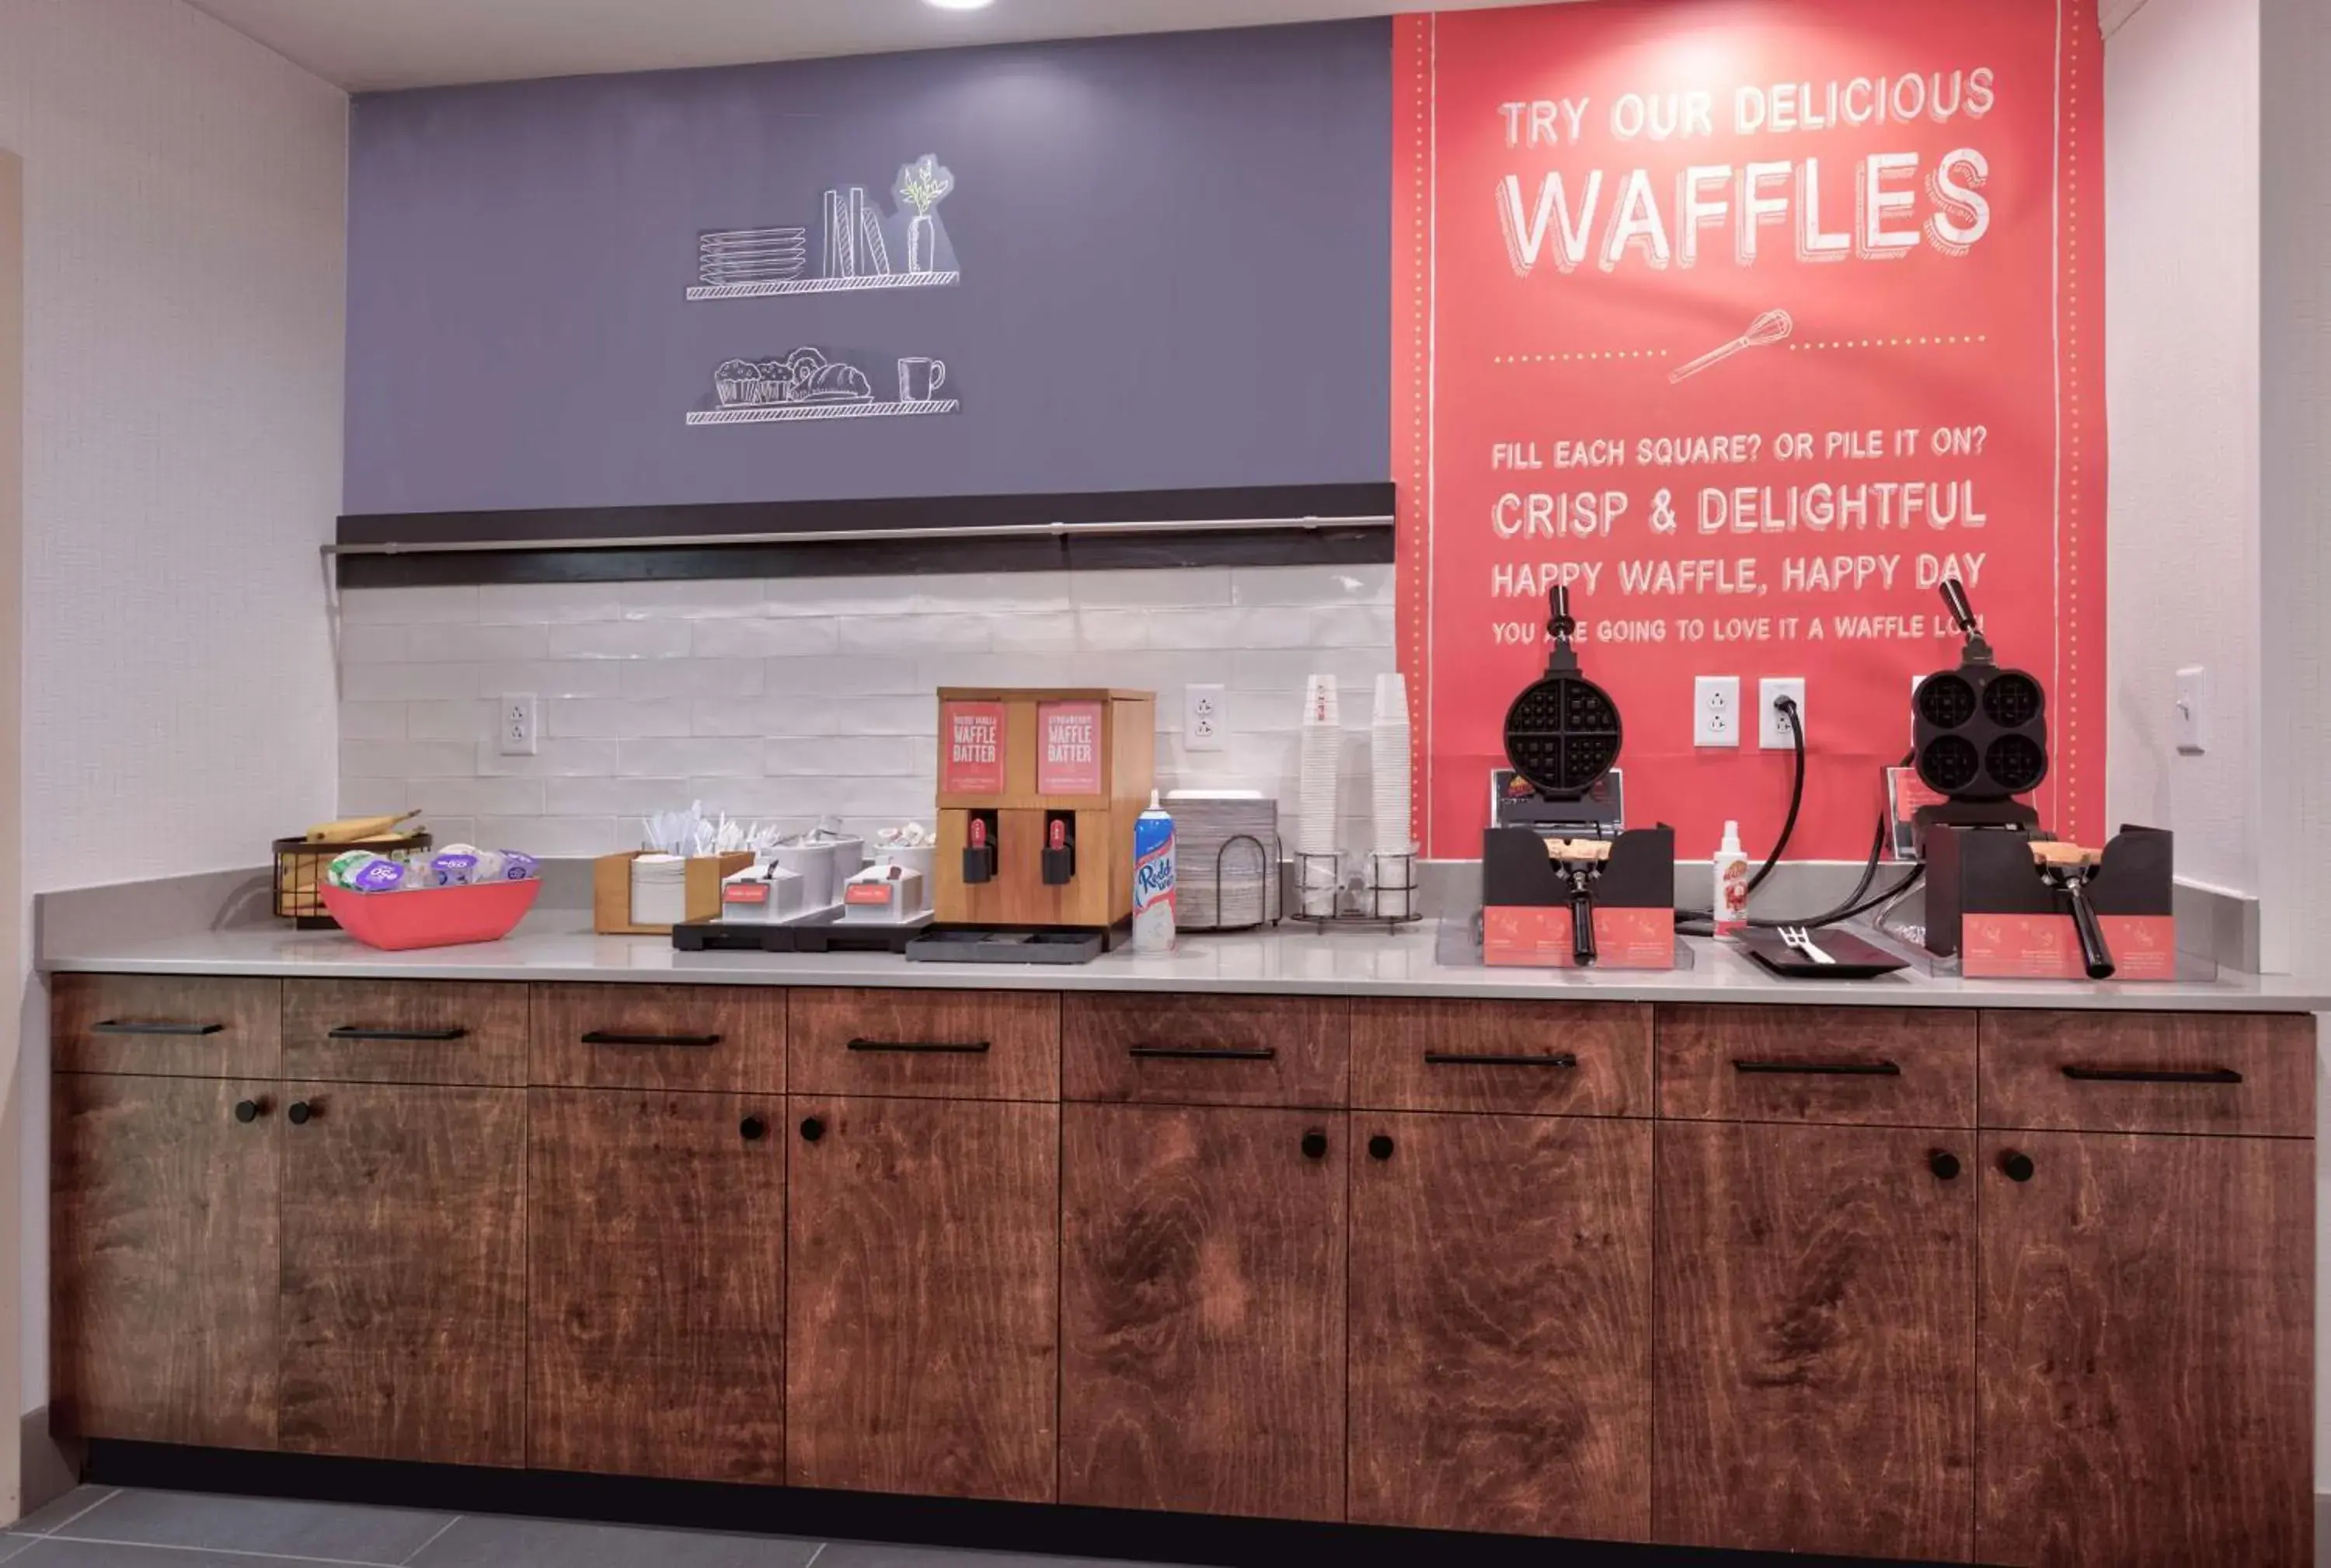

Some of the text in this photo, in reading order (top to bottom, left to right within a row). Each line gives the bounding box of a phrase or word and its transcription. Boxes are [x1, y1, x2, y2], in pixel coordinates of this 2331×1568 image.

[1497, 67, 1995, 149] TRY OUR DELICIOUS
[1494, 148, 1991, 279] WAFFLES
[1492, 425, 1987, 470] FILL EACH SQUARE? OR PILE IT ON?
[1491, 479, 1987, 539] CRISP & DELIGHTFUL
[1491, 552, 1986, 598] HAPPY WAFFLE, HAPPY DAY
[1492, 622, 1535, 645] YOU
[1597, 620, 1666, 643] GOING
[1676, 618, 1704, 642] TO
[1713, 617, 1771, 641] LOVE
[1779, 617, 1800, 640] IT
[1807, 617, 1824, 640] A
[1834, 615, 1925, 638] WAFFLE
[1933, 613, 1984, 637] LO!
[953, 725, 996, 744] WAFFLE
[953, 744, 995, 763] BATTER
[1047, 744, 1091, 763] BATTER
[1048, 725, 1092, 744] WAFFLE
